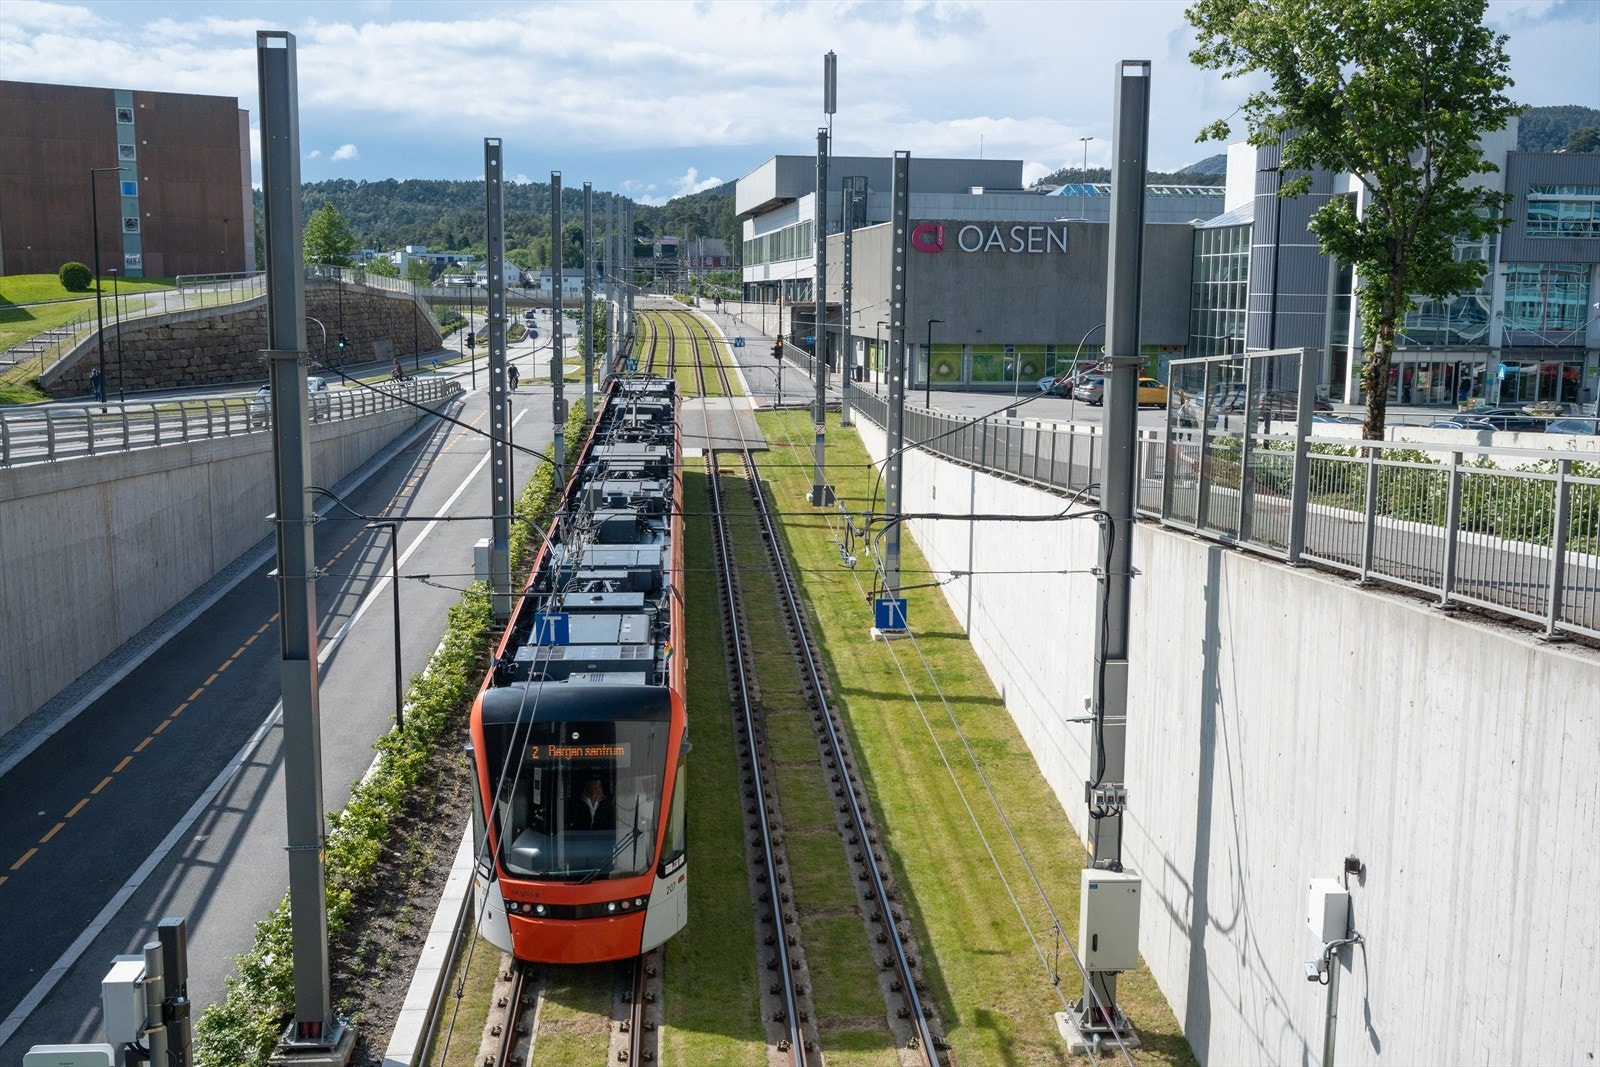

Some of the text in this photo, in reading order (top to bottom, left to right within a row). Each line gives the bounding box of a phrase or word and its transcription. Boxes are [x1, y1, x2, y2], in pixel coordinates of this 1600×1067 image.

[958, 224, 1068, 253] OASEN
[882, 601, 901, 627] T
[542, 615, 562, 642] T
[532, 744, 625, 760] 2 Bergen sentrum
[666, 881, 677, 895] 207
